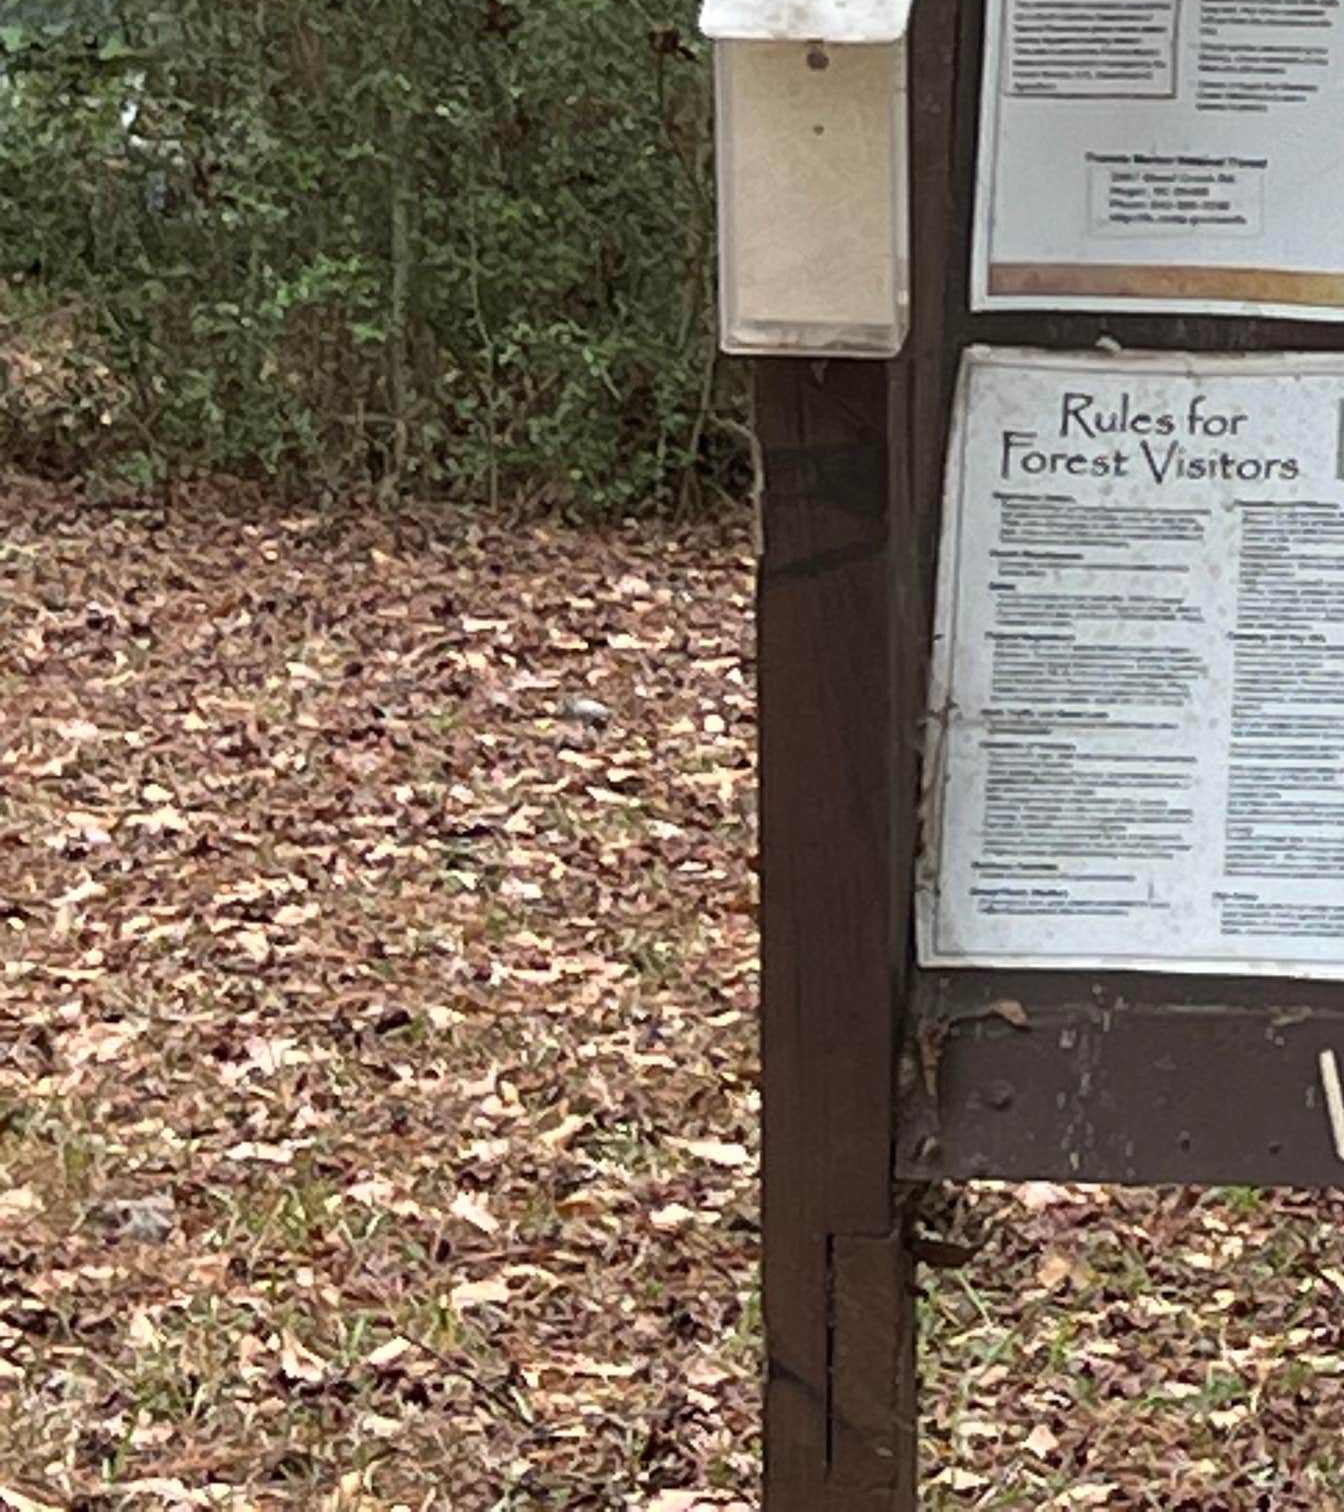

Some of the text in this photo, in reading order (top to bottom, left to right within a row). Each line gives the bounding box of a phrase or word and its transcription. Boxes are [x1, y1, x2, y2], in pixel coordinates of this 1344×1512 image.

[1060, 392, 1248, 438] Rules for
[1001, 430, 1129, 479] Forest
[1140, 440, 1300, 484] Visitors
